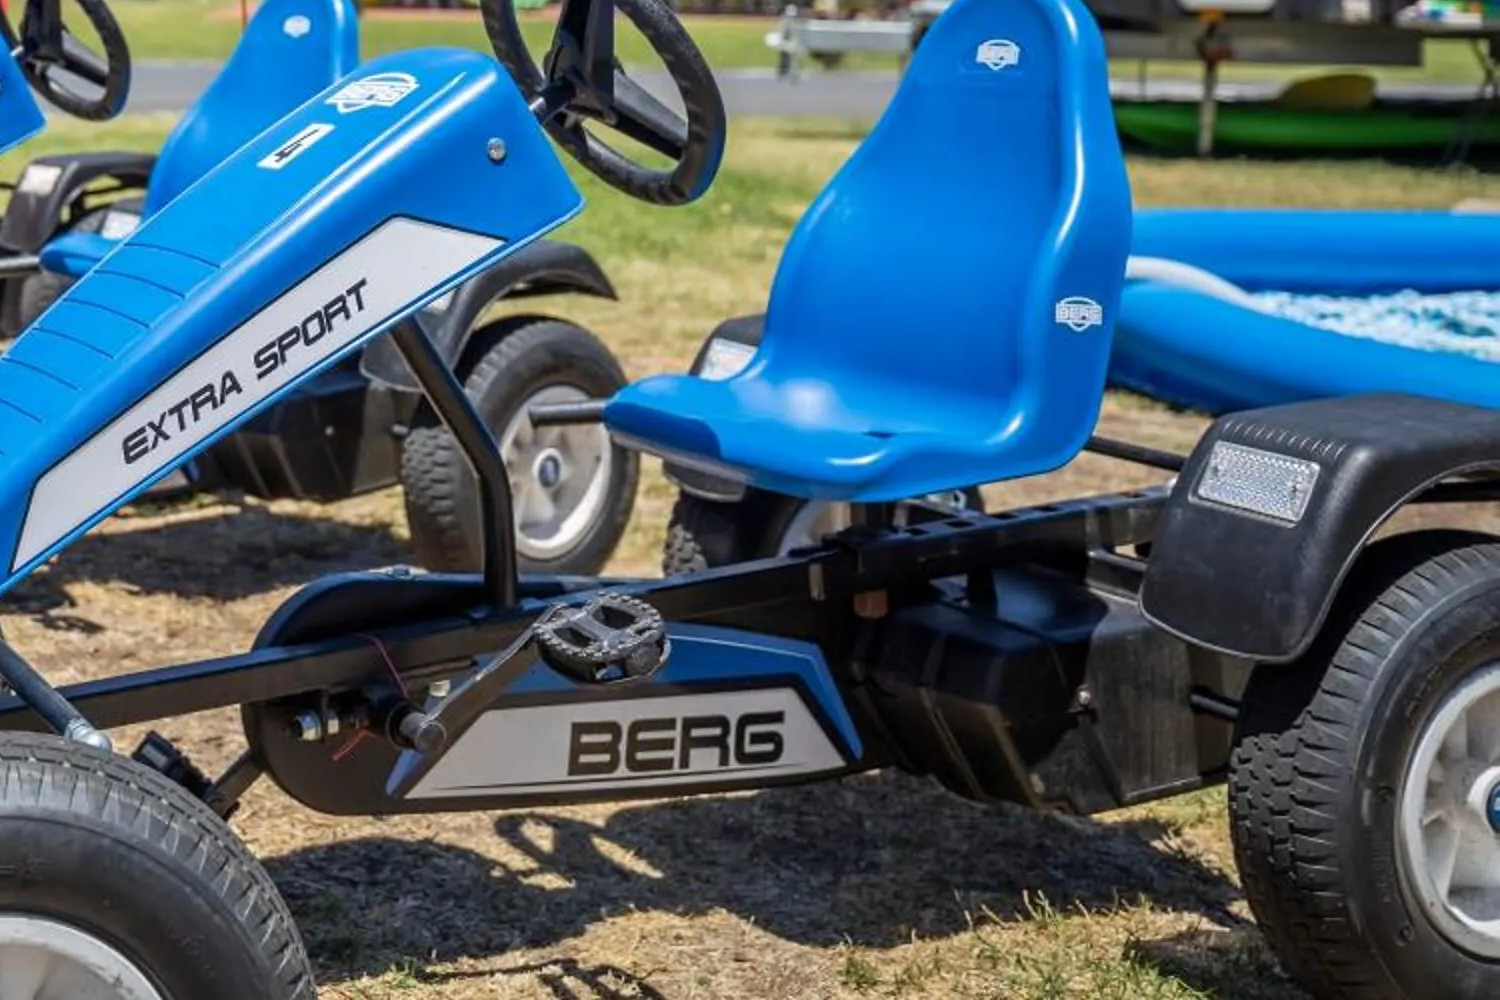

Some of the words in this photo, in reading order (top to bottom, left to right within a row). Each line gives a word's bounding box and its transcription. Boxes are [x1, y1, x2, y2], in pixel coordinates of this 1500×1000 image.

[121, 370, 243, 466] EXTRA
[253, 278, 368, 381] SPORT
[566, 710, 787, 777] BERG
